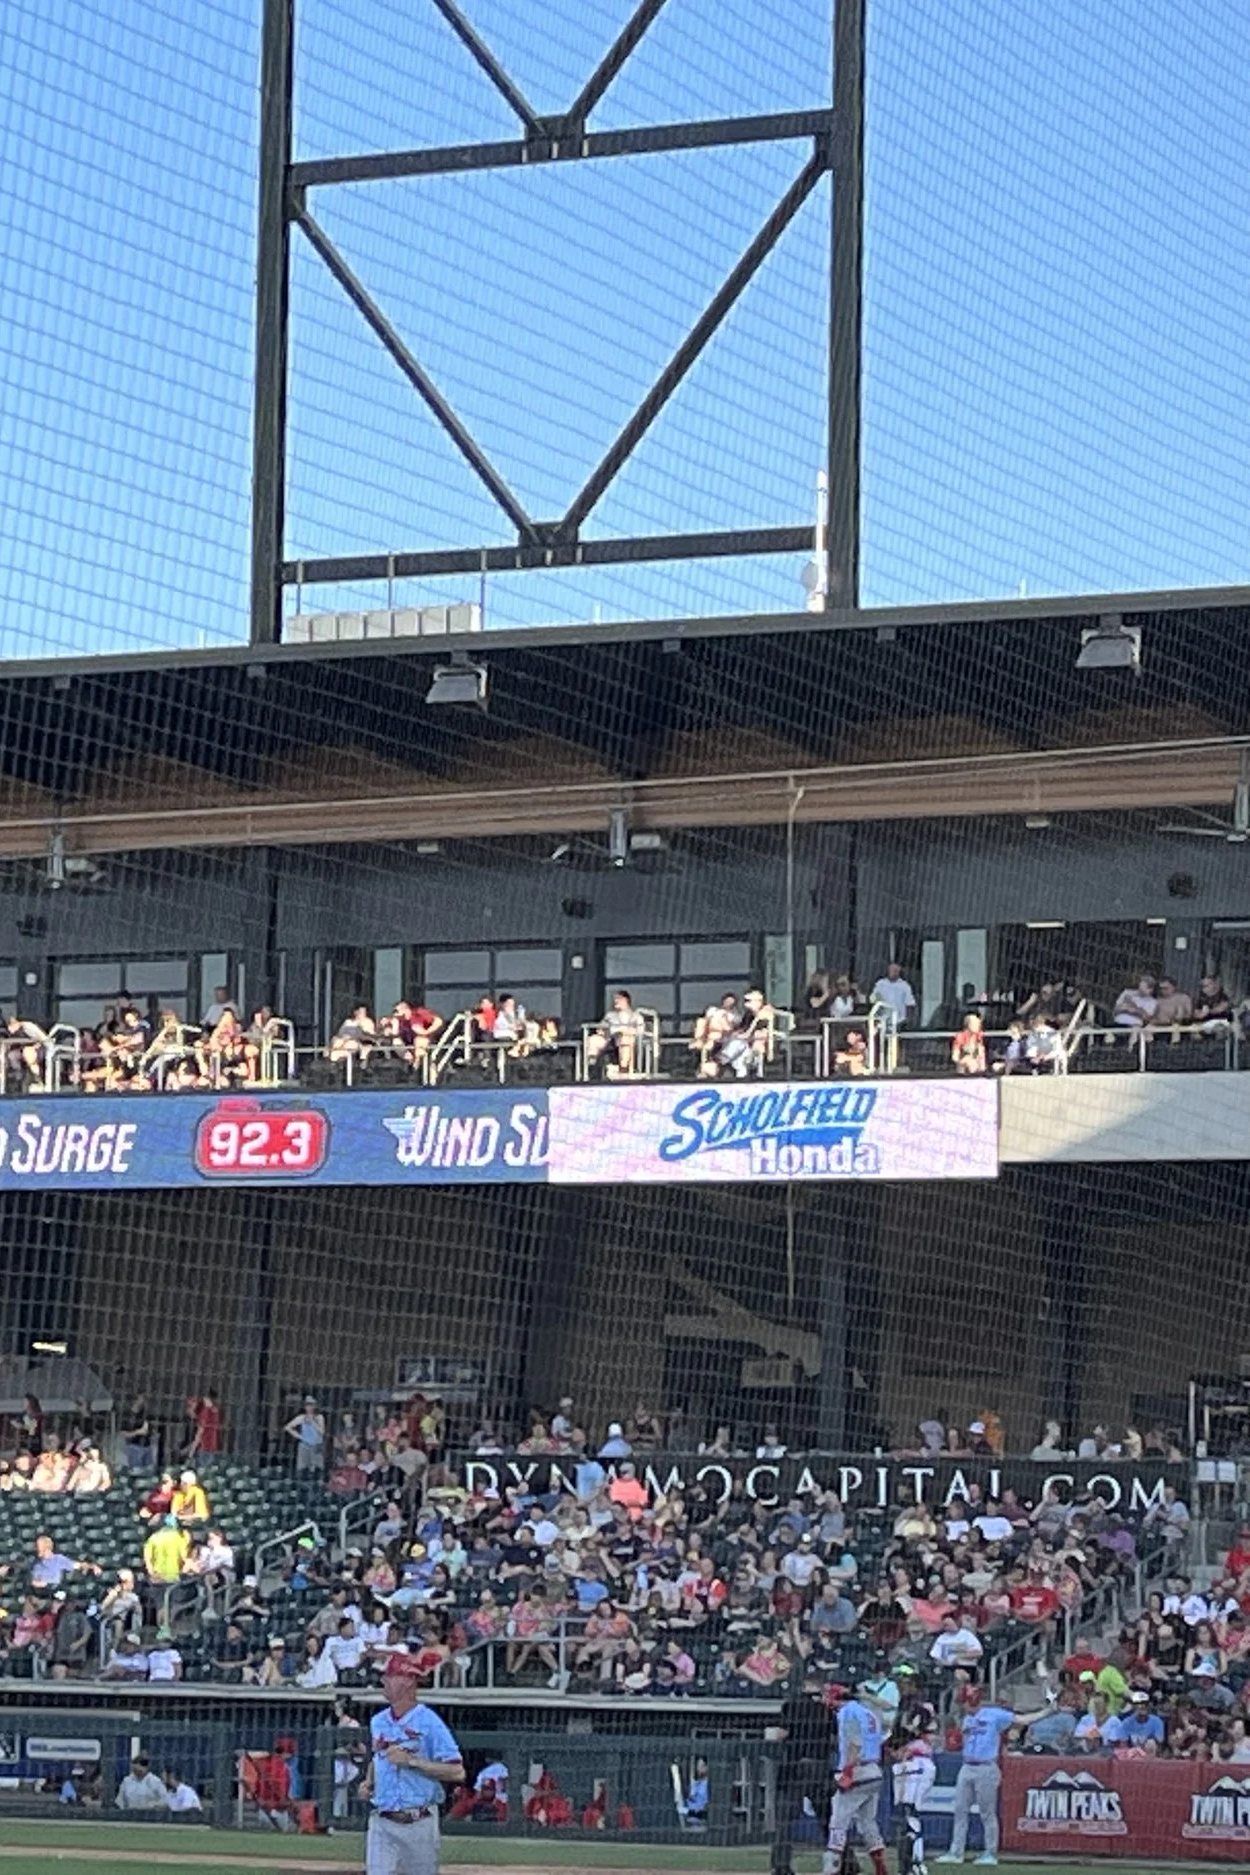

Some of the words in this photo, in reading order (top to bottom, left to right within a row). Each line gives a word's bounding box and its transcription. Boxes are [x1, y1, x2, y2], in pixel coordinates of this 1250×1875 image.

[10, 1113, 138, 1174] SURGE
[209, 1120, 312, 1167] 92.3
[391, 1105, 501, 1168] WIND
[659, 1086, 878, 1162] SCHOLFIELD
[750, 1134, 881, 1175] Honda
[464, 1460, 1167, 1512] DYNMOCAPITA.COM
[1026, 1787, 1069, 1821] TWIN
[1070, 1789, 1124, 1823] PEAKS
